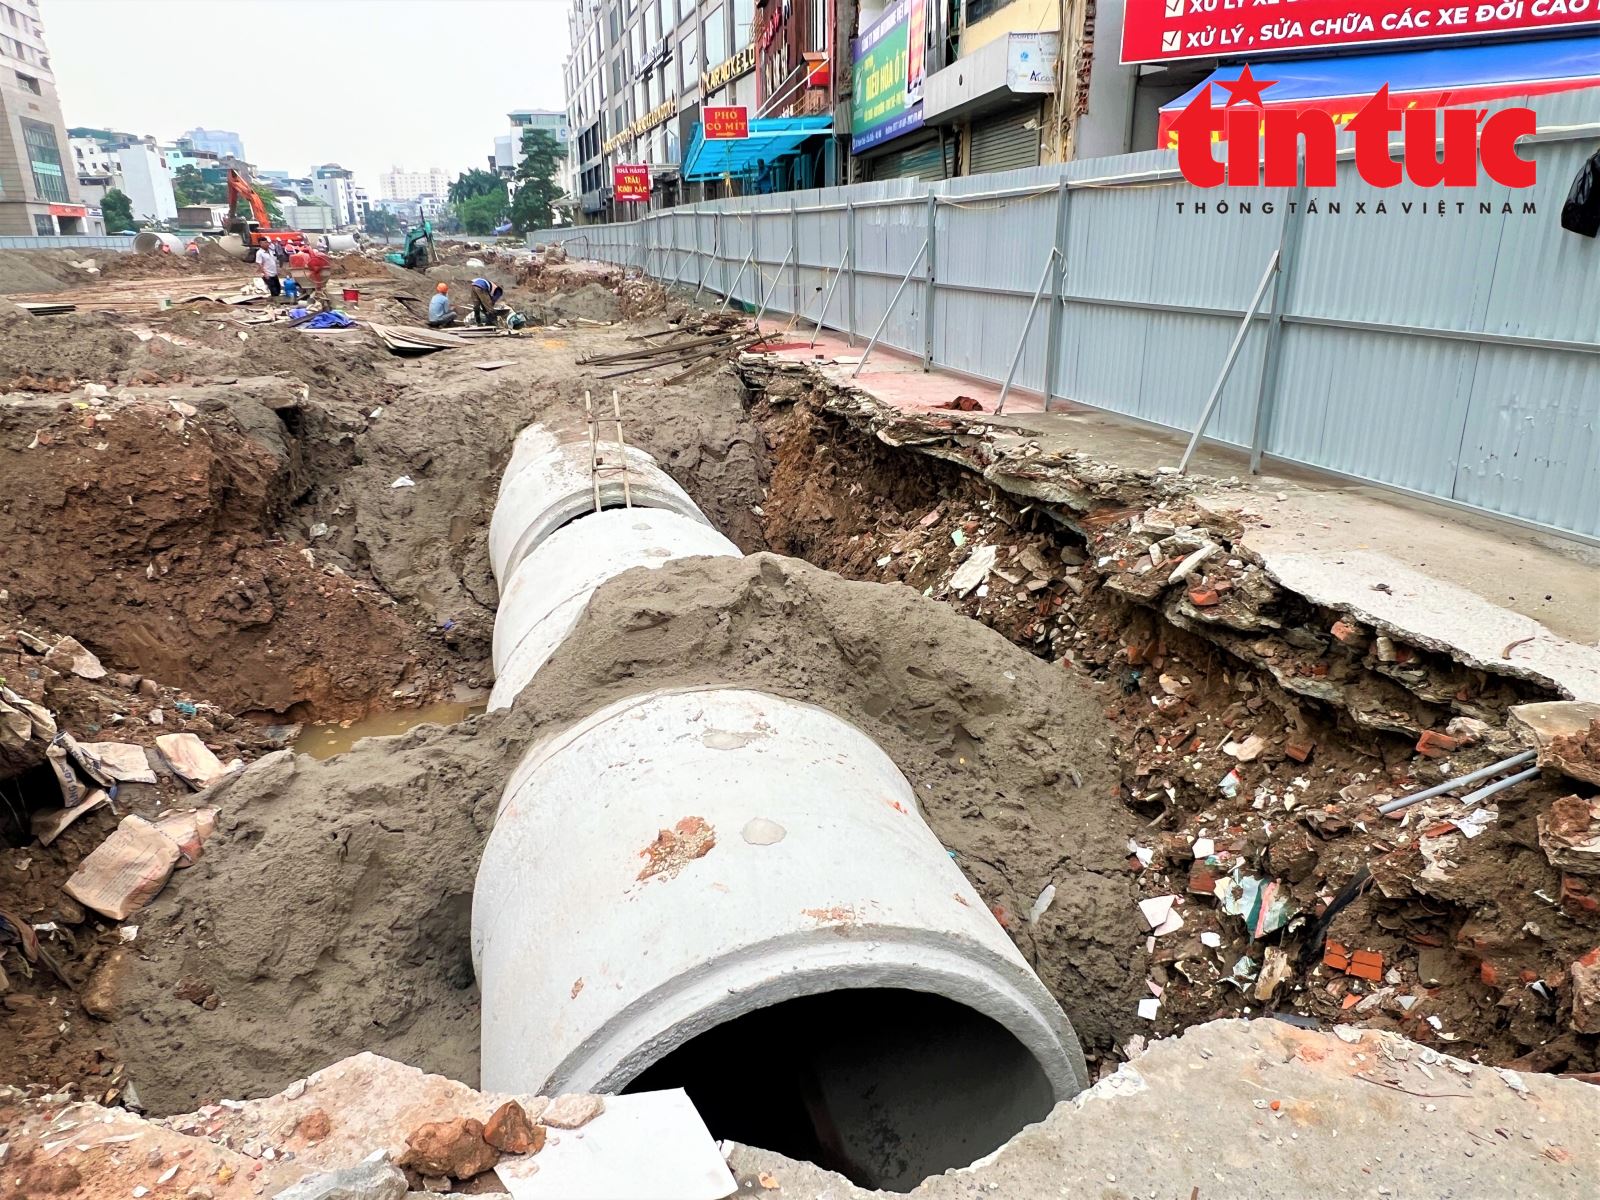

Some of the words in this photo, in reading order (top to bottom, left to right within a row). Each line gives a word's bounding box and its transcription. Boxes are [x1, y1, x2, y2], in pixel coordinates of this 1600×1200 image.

[1186, 25, 1217, 48] XỬ
[1220, 23, 1245, 45] LÝ
[1259, 17, 1304, 41] SỬA
[1310, 13, 1375, 36] CHỮA
[1381, 8, 1431, 30] CÁC
[1436, 7, 1470, 26] XE
[1475, 0, 1524, 22] ĐỜI
[1531, 0, 1590, 17] CAO
